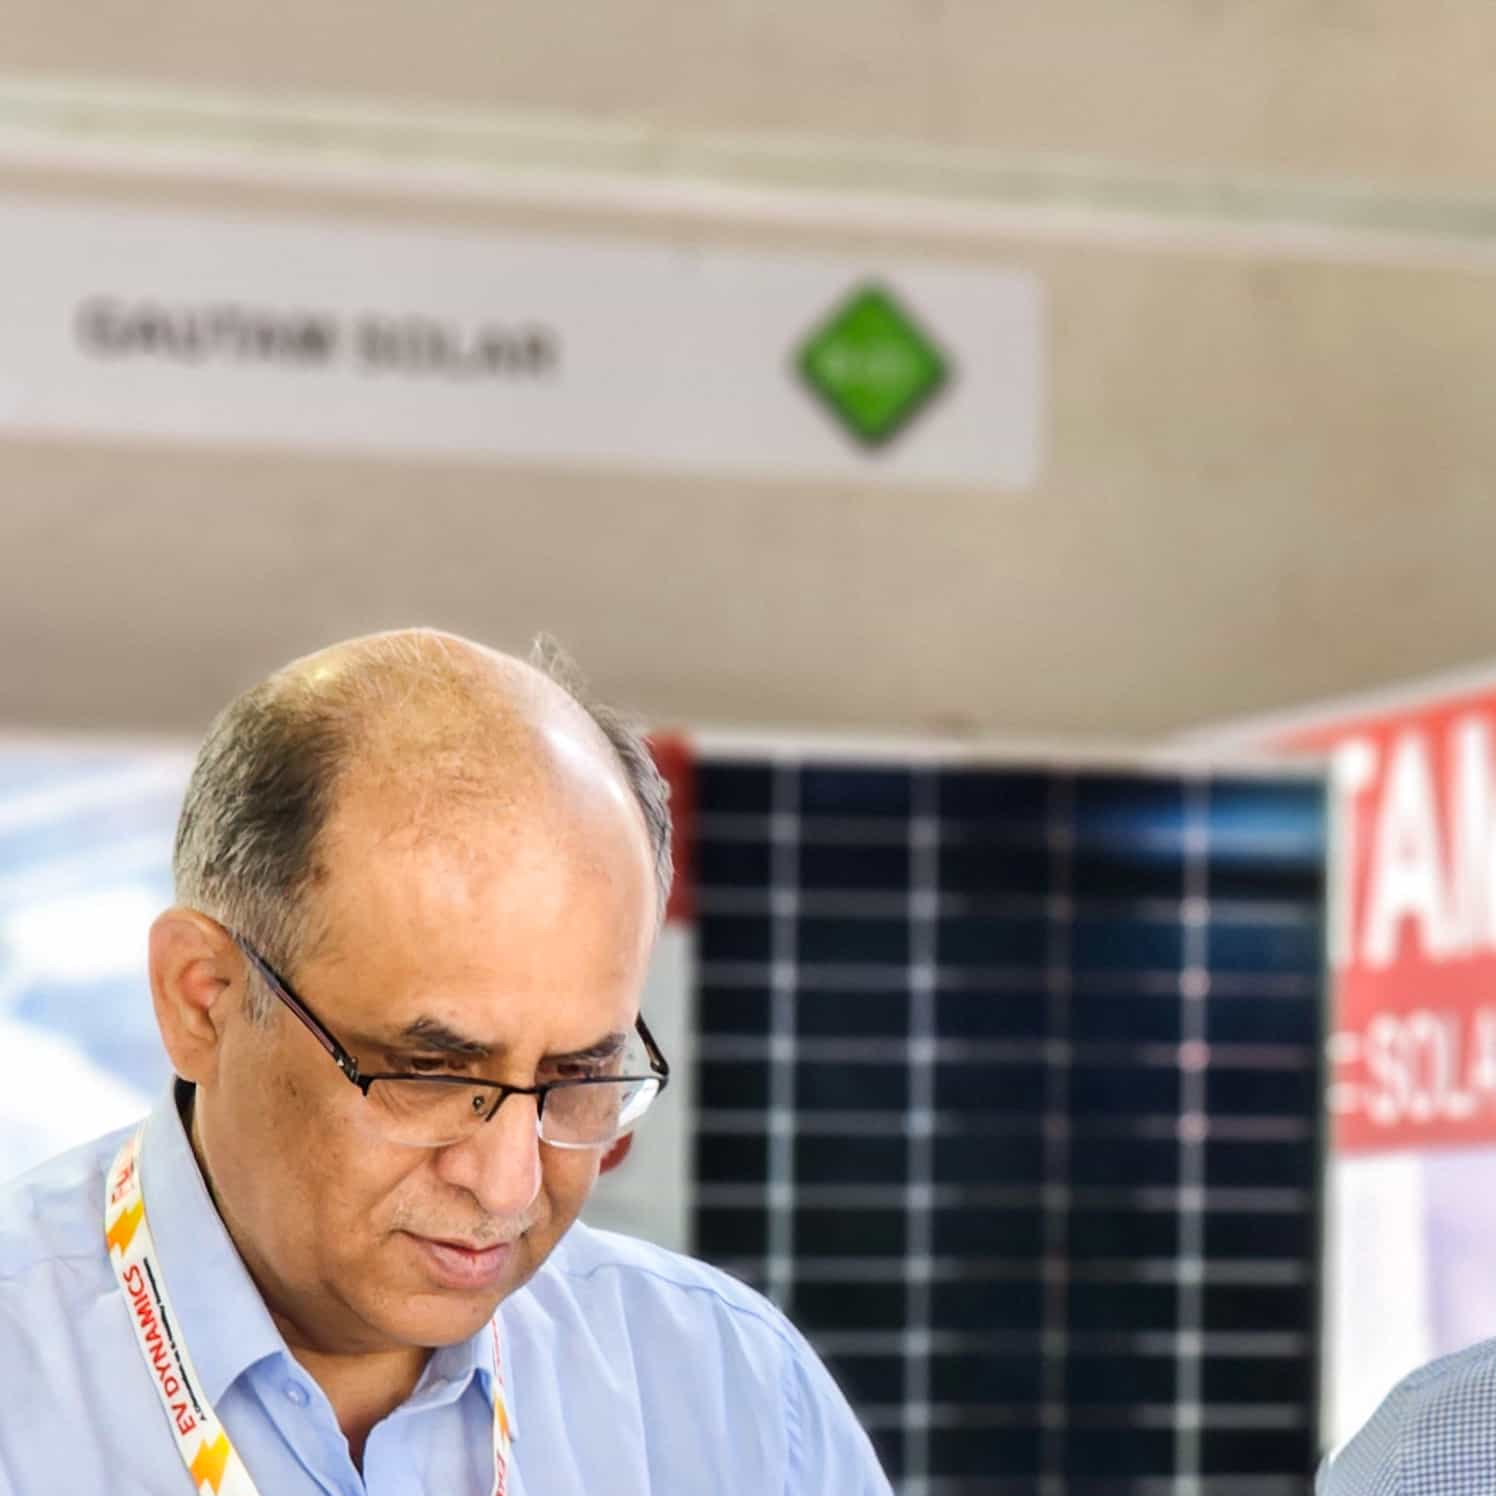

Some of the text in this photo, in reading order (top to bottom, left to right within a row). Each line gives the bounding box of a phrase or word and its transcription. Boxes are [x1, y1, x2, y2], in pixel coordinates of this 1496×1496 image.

[77, 299, 560, 380] GAUTAM SOLAR
[122, 1263, 180, 1399] DYNAMICS
[171, 1402, 197, 1436] EV
